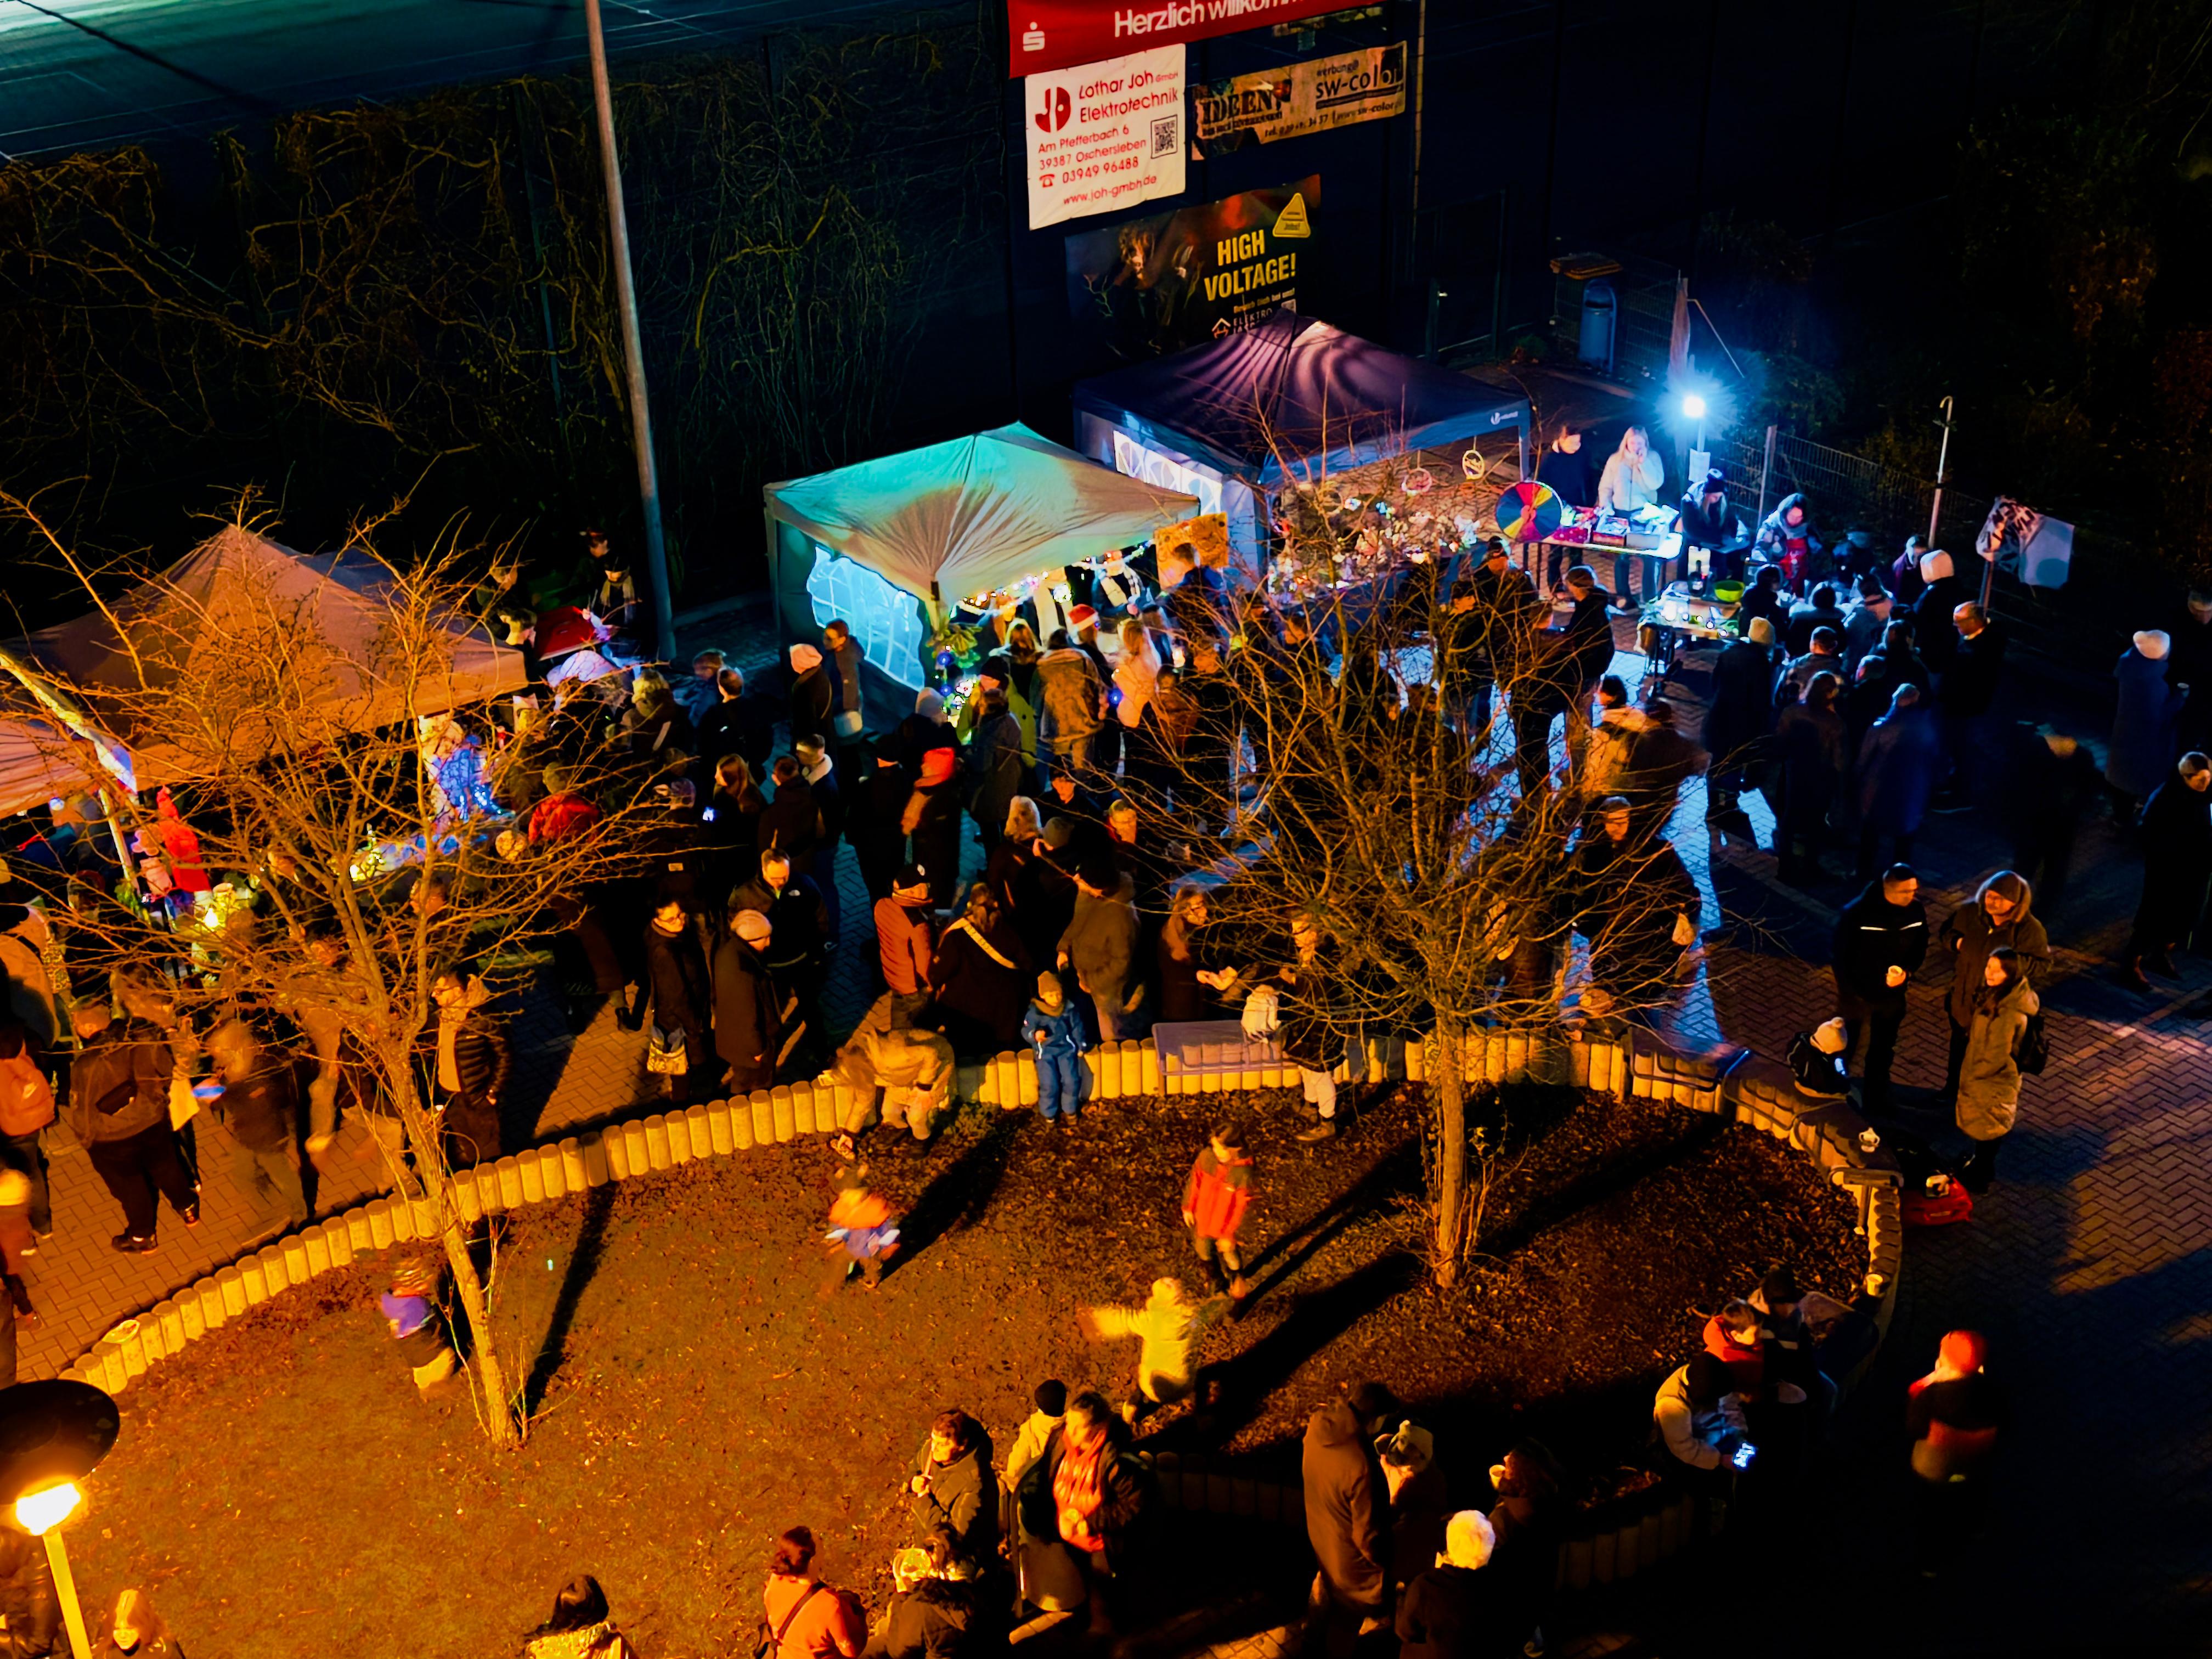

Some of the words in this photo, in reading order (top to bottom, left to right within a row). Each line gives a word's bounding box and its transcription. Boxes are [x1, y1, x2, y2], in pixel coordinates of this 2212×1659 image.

[1114, 0, 1205, 37] Herzlich
[1079, 79, 1124, 99] Lothar
[1128, 70, 1154, 89] Joh
[1155, 71, 1179, 83] GmbH
[1080, 87, 1178, 123] Elektrotechnik
[1038, 143, 1056, 153] Am
[1060, 128, 1119, 149] Pfefferbach
[1122, 124, 1130, 135] 6
[1040, 154, 1071, 170] 39387
[1076, 139, 1147, 163] Oschersleben
[1062, 165, 1099, 183] 03949
[1103, 156, 1139, 174] 96488
[1063, 174, 1157, 205] www.joh-gmbh.de
[1217, 229, 1265, 266] HIGH
[1204, 252, 1296, 301] VOLTAGE!
